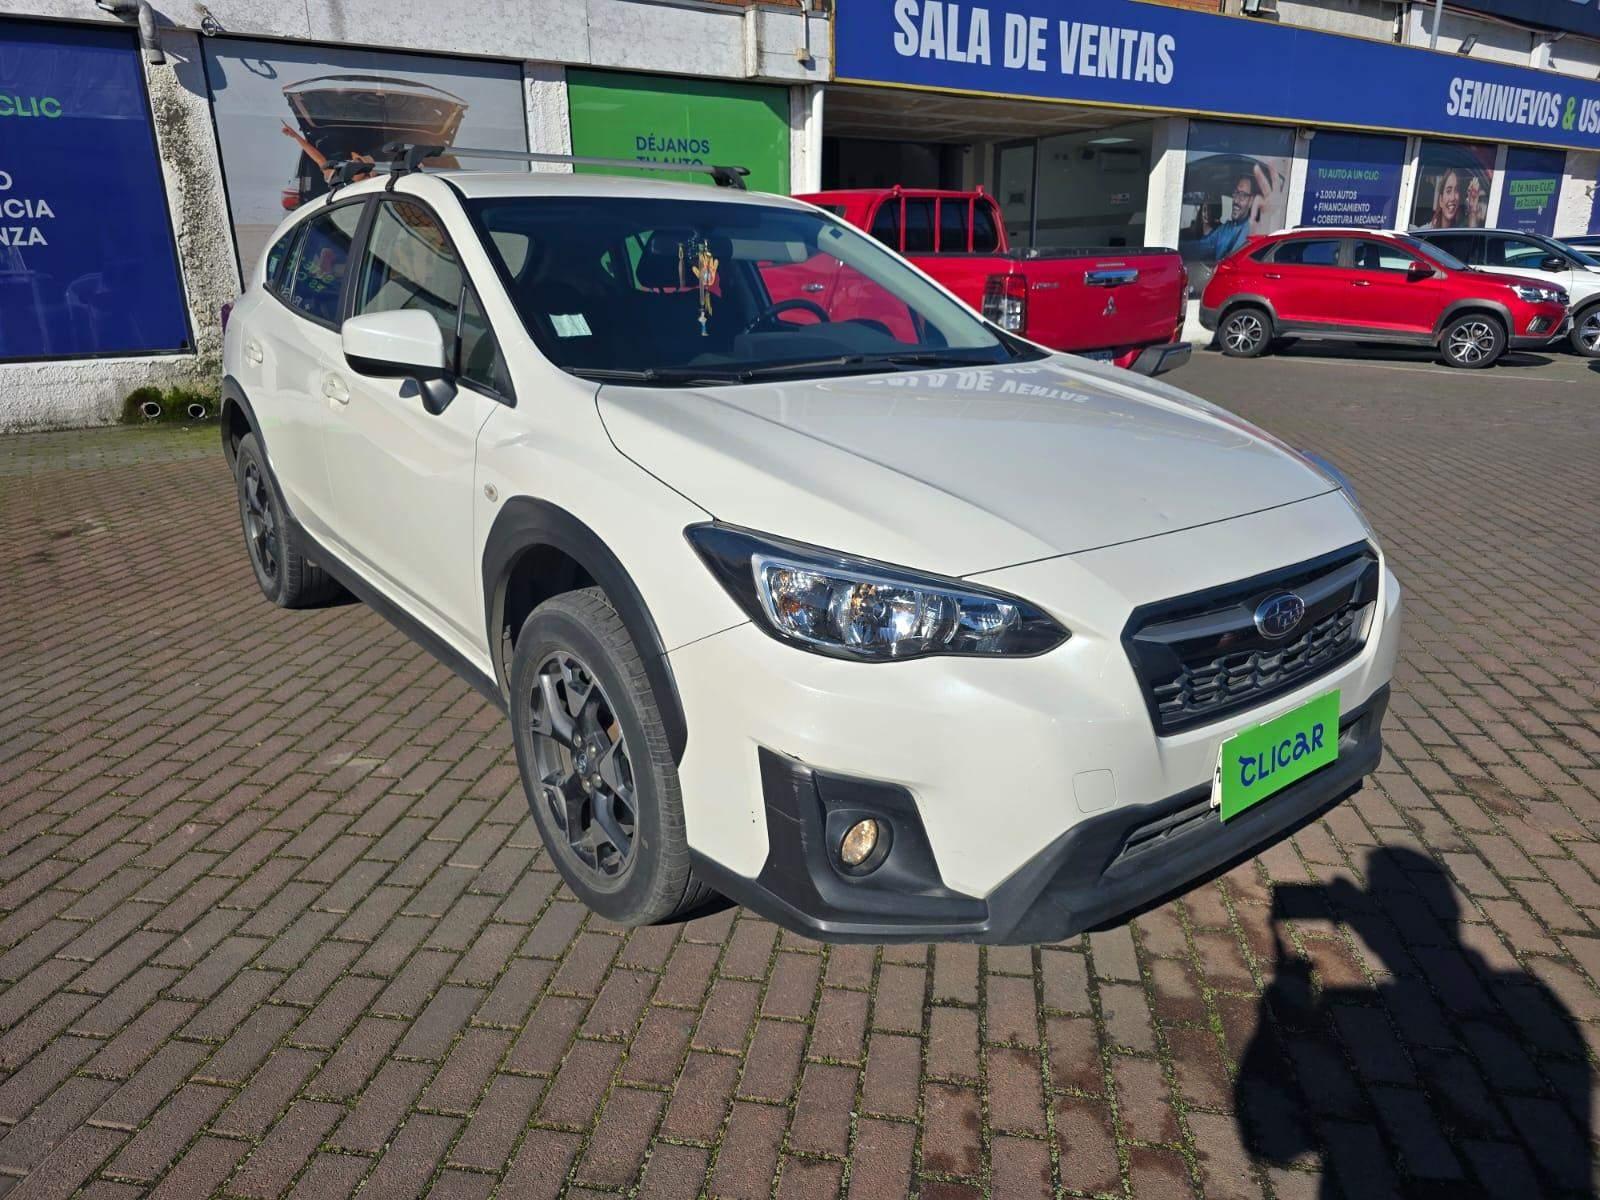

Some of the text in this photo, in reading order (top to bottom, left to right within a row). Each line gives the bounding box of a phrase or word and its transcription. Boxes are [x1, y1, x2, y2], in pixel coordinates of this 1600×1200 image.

[893, 0, 1176, 85] SALA DE VENTAS
[0, 95, 63, 117] CLIC
[1446, 77, 1562, 128] SEMINUEVOS
[1562, 96, 1577, 130] &
[636, 132, 710, 154] DÉJANOS
[1318, 167, 1328, 179] TU
[1328, 168, 1346, 179] AUTO
[1363, 170, 1380, 181] CLIC
[1337, 190, 1357, 200] AUTOS
[0, 198, 55, 218] CIA
[1318, 202, 1370, 212] FINANCIAMIENTO
[1317, 214, 1353, 224] COBERTURA
